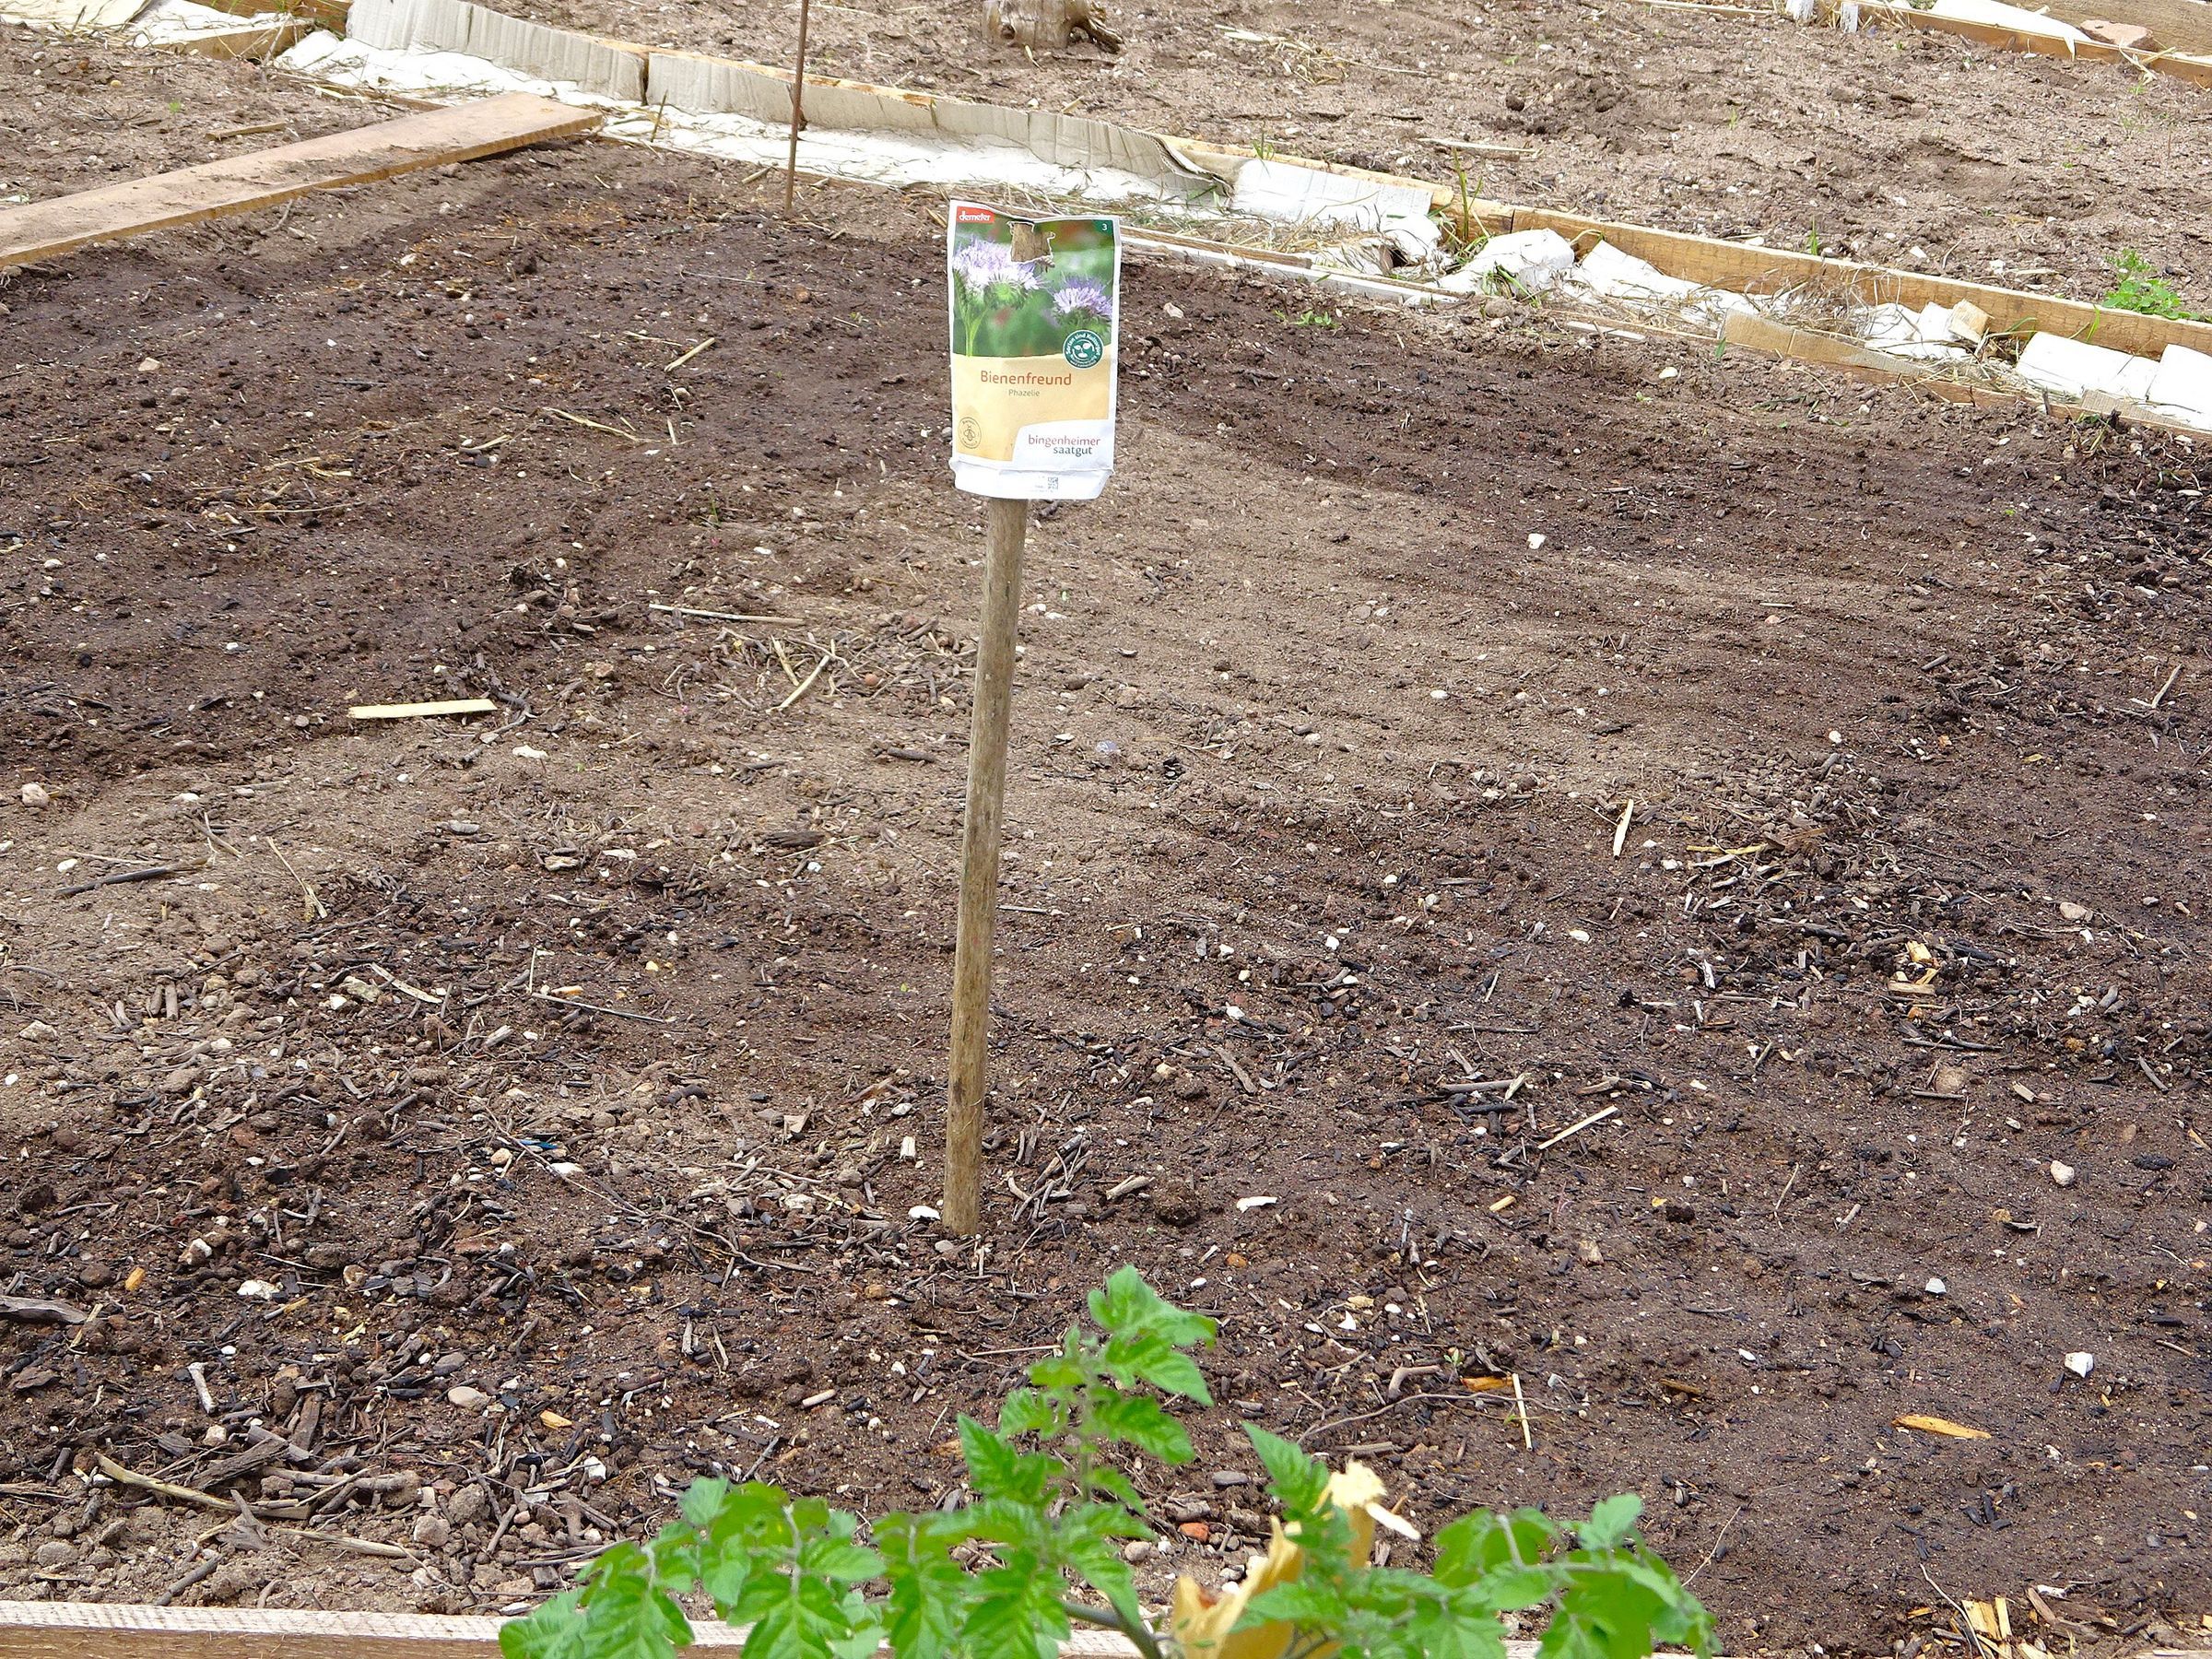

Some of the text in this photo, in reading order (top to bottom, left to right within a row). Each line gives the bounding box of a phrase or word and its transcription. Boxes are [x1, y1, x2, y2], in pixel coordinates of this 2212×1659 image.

[959, 210, 991, 221] demeter
[1101, 223, 1108, 231] 3
[981, 370, 1072, 385] Bienenfreund
[1008, 389, 1041, 397] Phazelie
[1029, 434, 1100, 448] bingenheimer
[1053, 446, 1093, 457] saatgut
